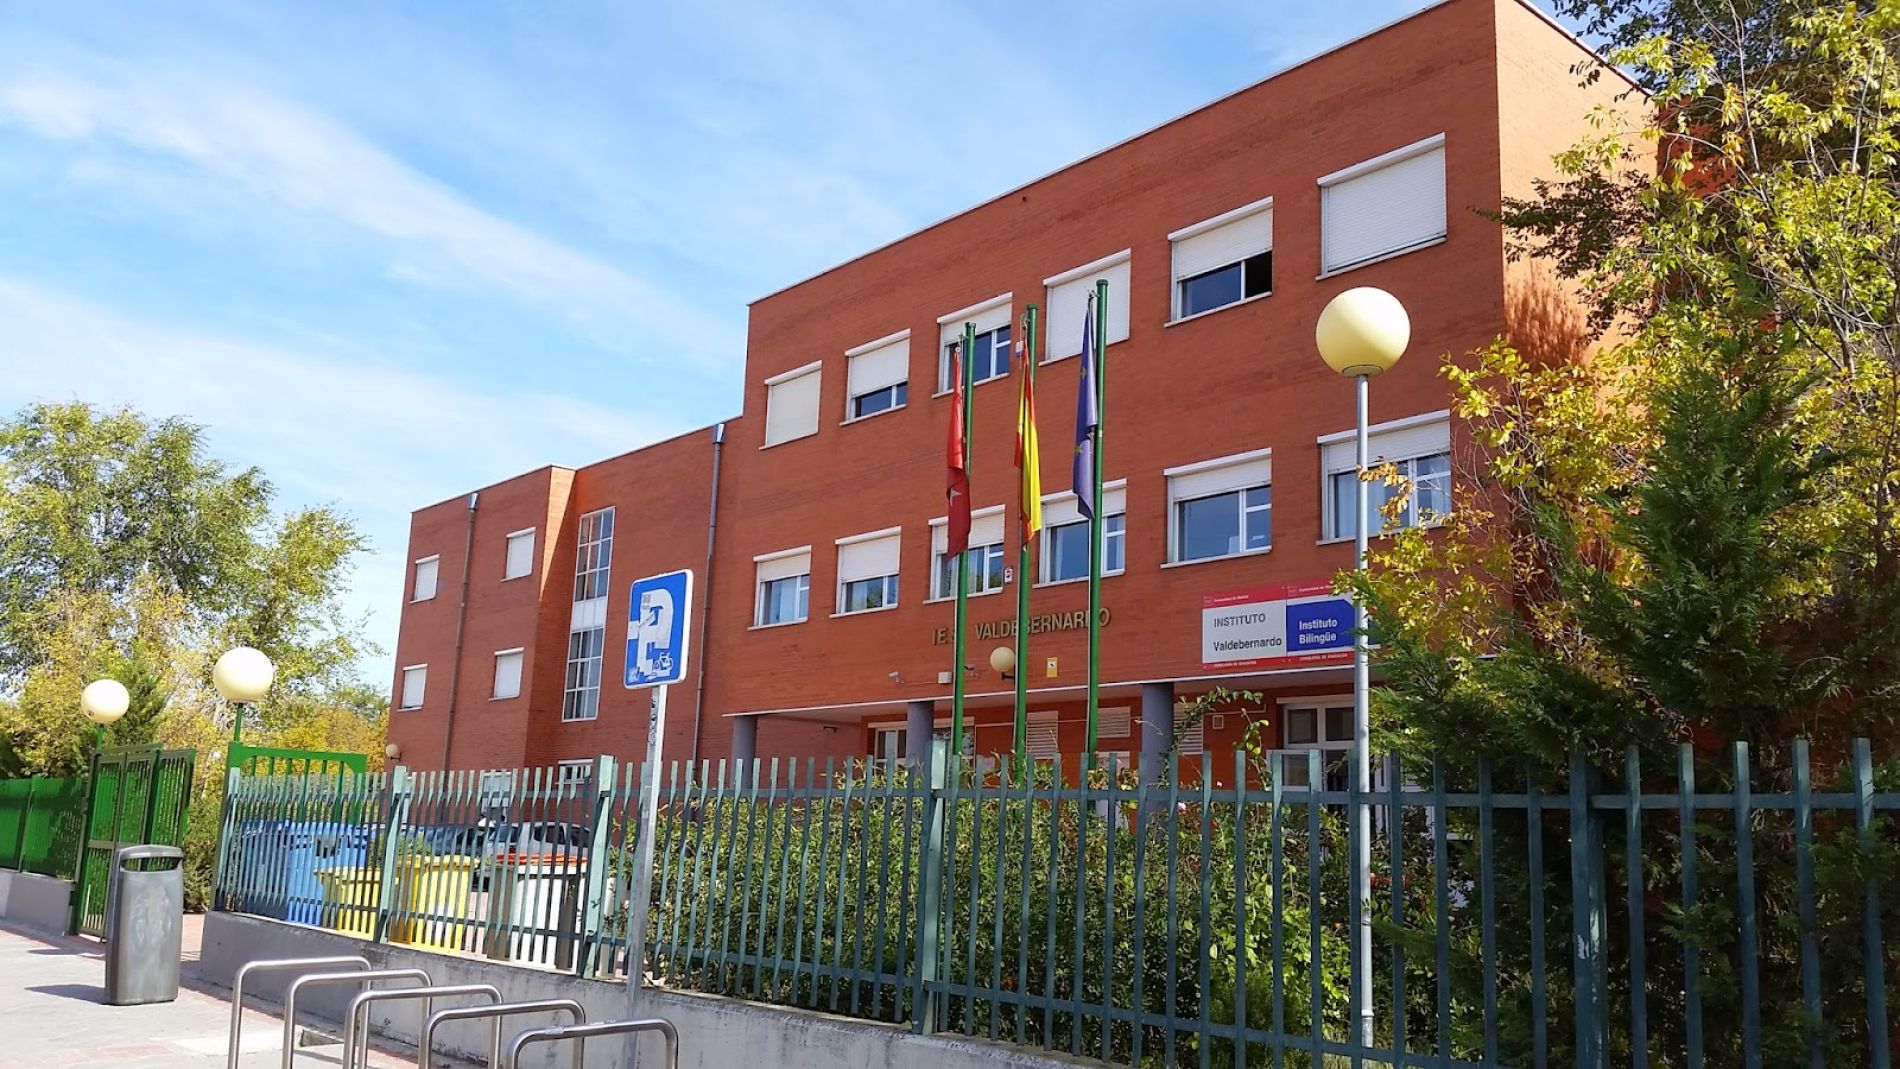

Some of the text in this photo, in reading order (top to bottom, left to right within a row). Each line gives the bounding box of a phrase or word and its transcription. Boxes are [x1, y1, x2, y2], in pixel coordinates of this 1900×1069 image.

[1214, 613, 1266, 628] INSTITUTO
[1299, 618, 1338, 630] Instituto
[1213, 637, 1282, 652] Valdebernardo
[1299, 631, 1337, 645] Bilingüe
